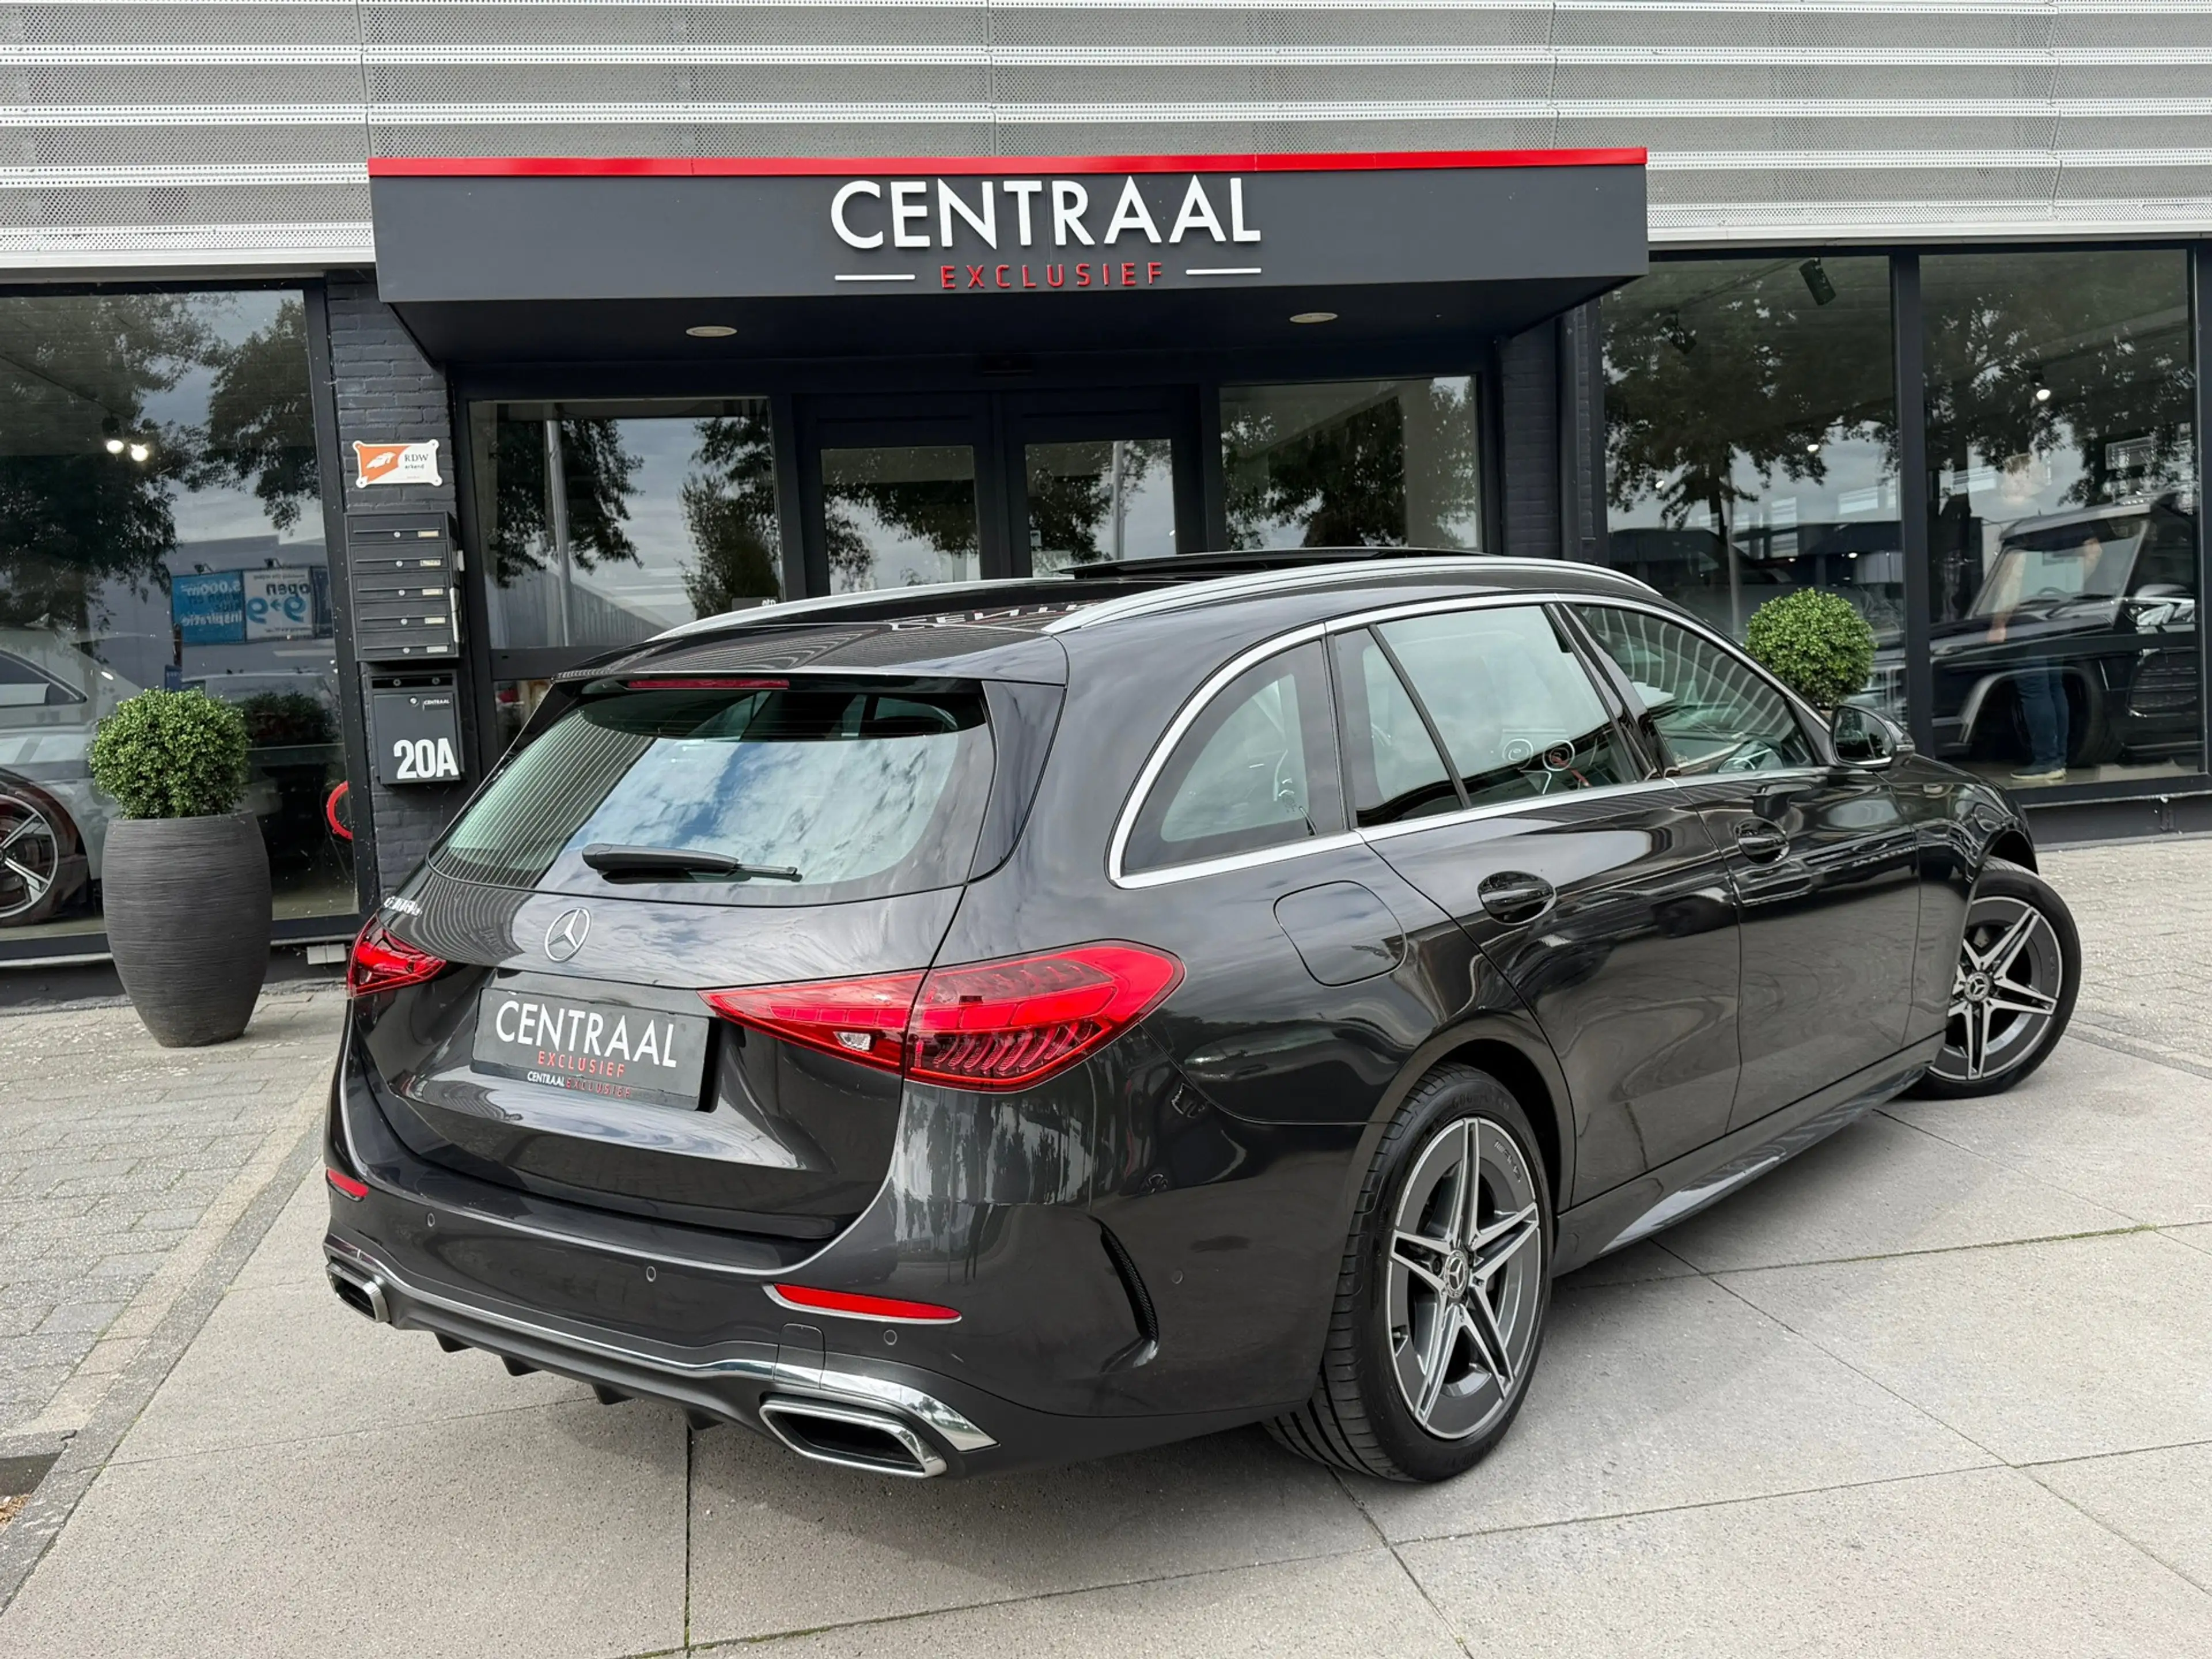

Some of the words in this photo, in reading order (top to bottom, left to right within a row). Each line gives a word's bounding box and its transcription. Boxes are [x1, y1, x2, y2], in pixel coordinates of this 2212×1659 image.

[831, 175, 1260, 249] CENTRAAL
[941, 262, 1162, 289] EXCLUSIEF
[393, 737, 459, 779] 20A
[495, 1000, 677, 1067] CENTRAAL
[537, 1051, 626, 1078] EXCLUSIEF
[527, 1071, 565, 1088] CENTRAAL
[566, 1077, 631, 1097] EXCLUSIEF
